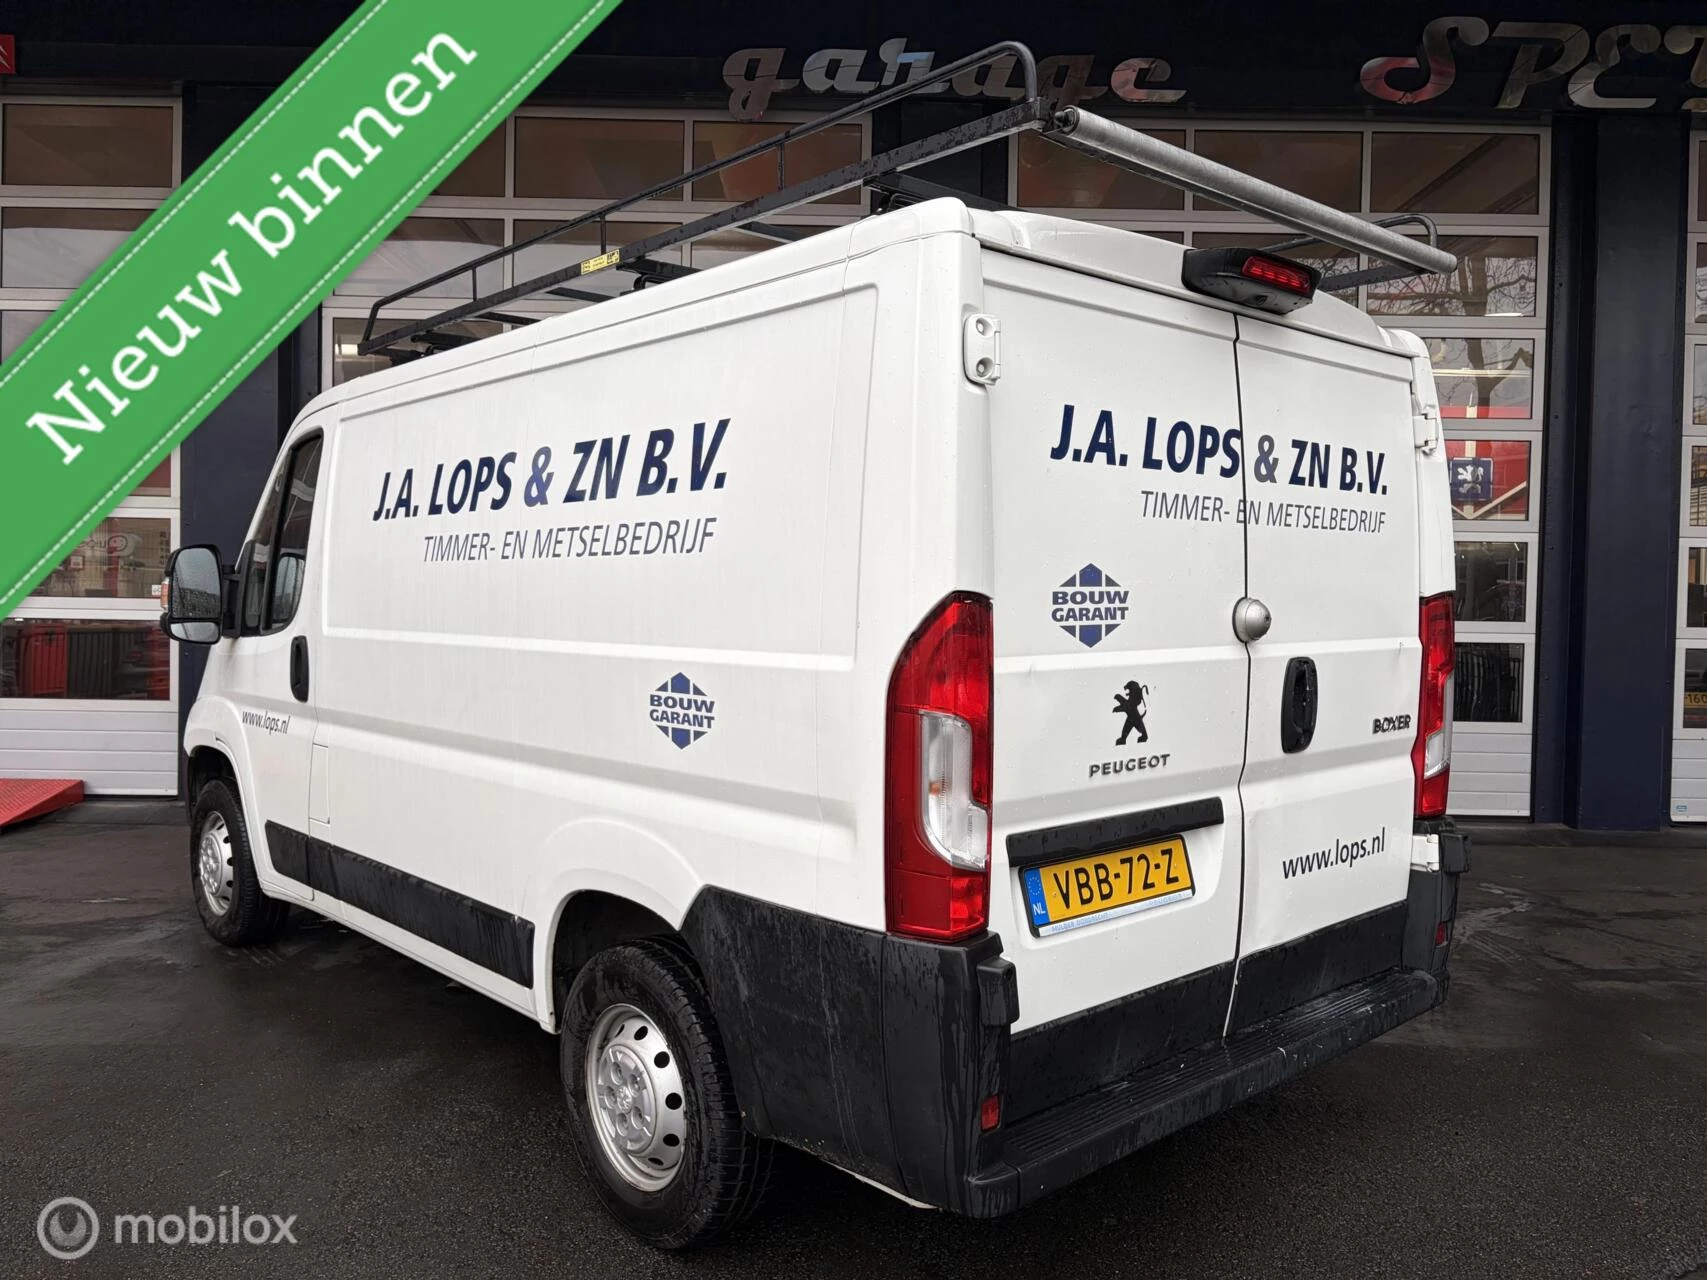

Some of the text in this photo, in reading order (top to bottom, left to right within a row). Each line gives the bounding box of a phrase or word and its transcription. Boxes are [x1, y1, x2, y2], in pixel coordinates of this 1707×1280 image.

[1050, 404, 1388, 496] J.A. LOPS & ZN B.V.
[372, 418, 731, 521] J.A. LOPS & ZN B.V.
[1141, 490, 1386, 534] TIMMER- EN METSELBEDRIJF
[423, 517, 717, 562] TIMMER- EN METSELBEDRIJF
[1052, 590, 1130, 606] BOUW
[1051, 606, 1129, 622] GARANT
[649, 693, 716, 713] BOUW
[242, 709, 291, 736] www.lops.nl
[649, 709, 715, 729] GARANT
[1372, 714, 1412, 735] BOXER
[1089, 753, 1171, 777] PEUGEOT
[1282, 826, 1386, 879] www.lops.nl
[1032, 847, 1180, 915] NL VBB-72-Z
